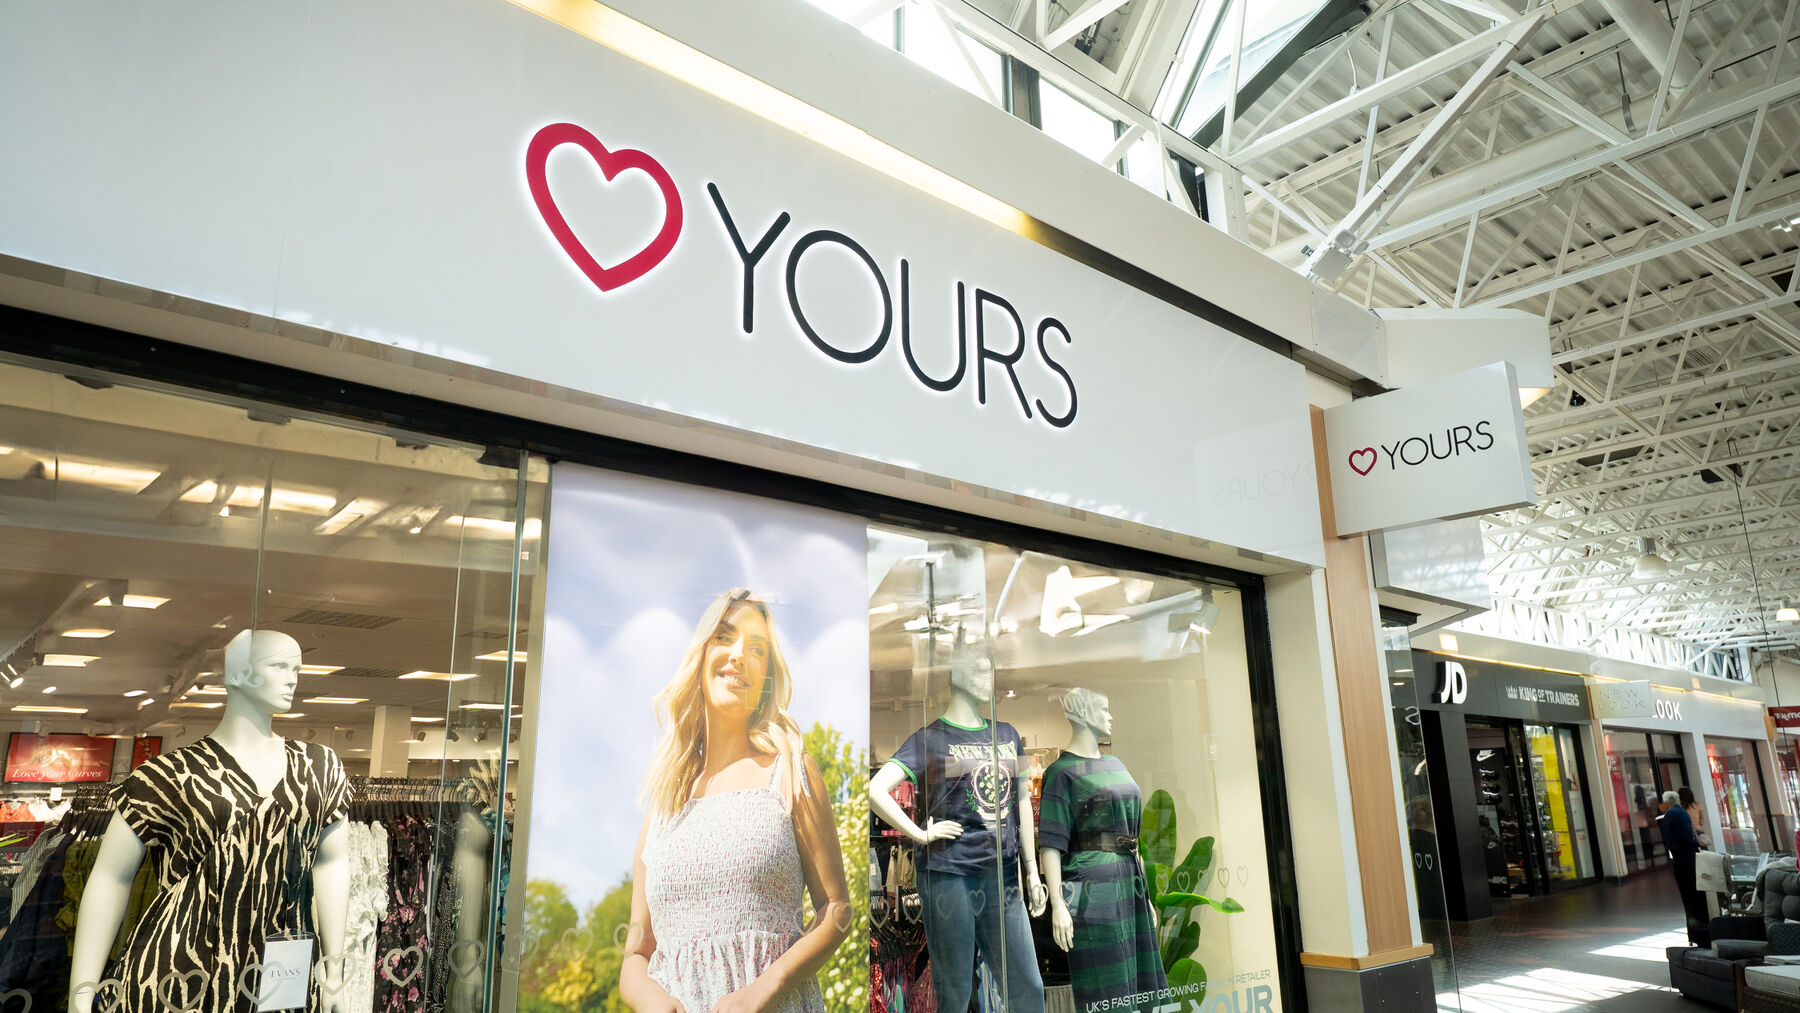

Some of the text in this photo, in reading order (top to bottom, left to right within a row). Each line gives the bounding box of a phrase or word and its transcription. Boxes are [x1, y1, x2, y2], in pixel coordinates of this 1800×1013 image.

[706, 181, 1078, 428] YOURS
[1381, 420, 1494, 470] YOURS
[1440, 660, 1468, 704] JD
[1518, 686, 1538, 702] KING
[1544, 689, 1580, 707] TRAINERS
[1600, 688, 1639, 699] NEW
[1599, 699, 1647, 711] LOOK
[1652, 699, 1683, 720] OOK
[12, 768, 103, 780] Love your Curves
[270, 967, 301, 979] EVANS
[1086, 998, 1110, 1013] UK'S
[1111, 990, 1156, 1008] FASTEST
[1157, 982, 1200, 1000] GROWING
[1235, 969, 1272, 984] RETAILER
